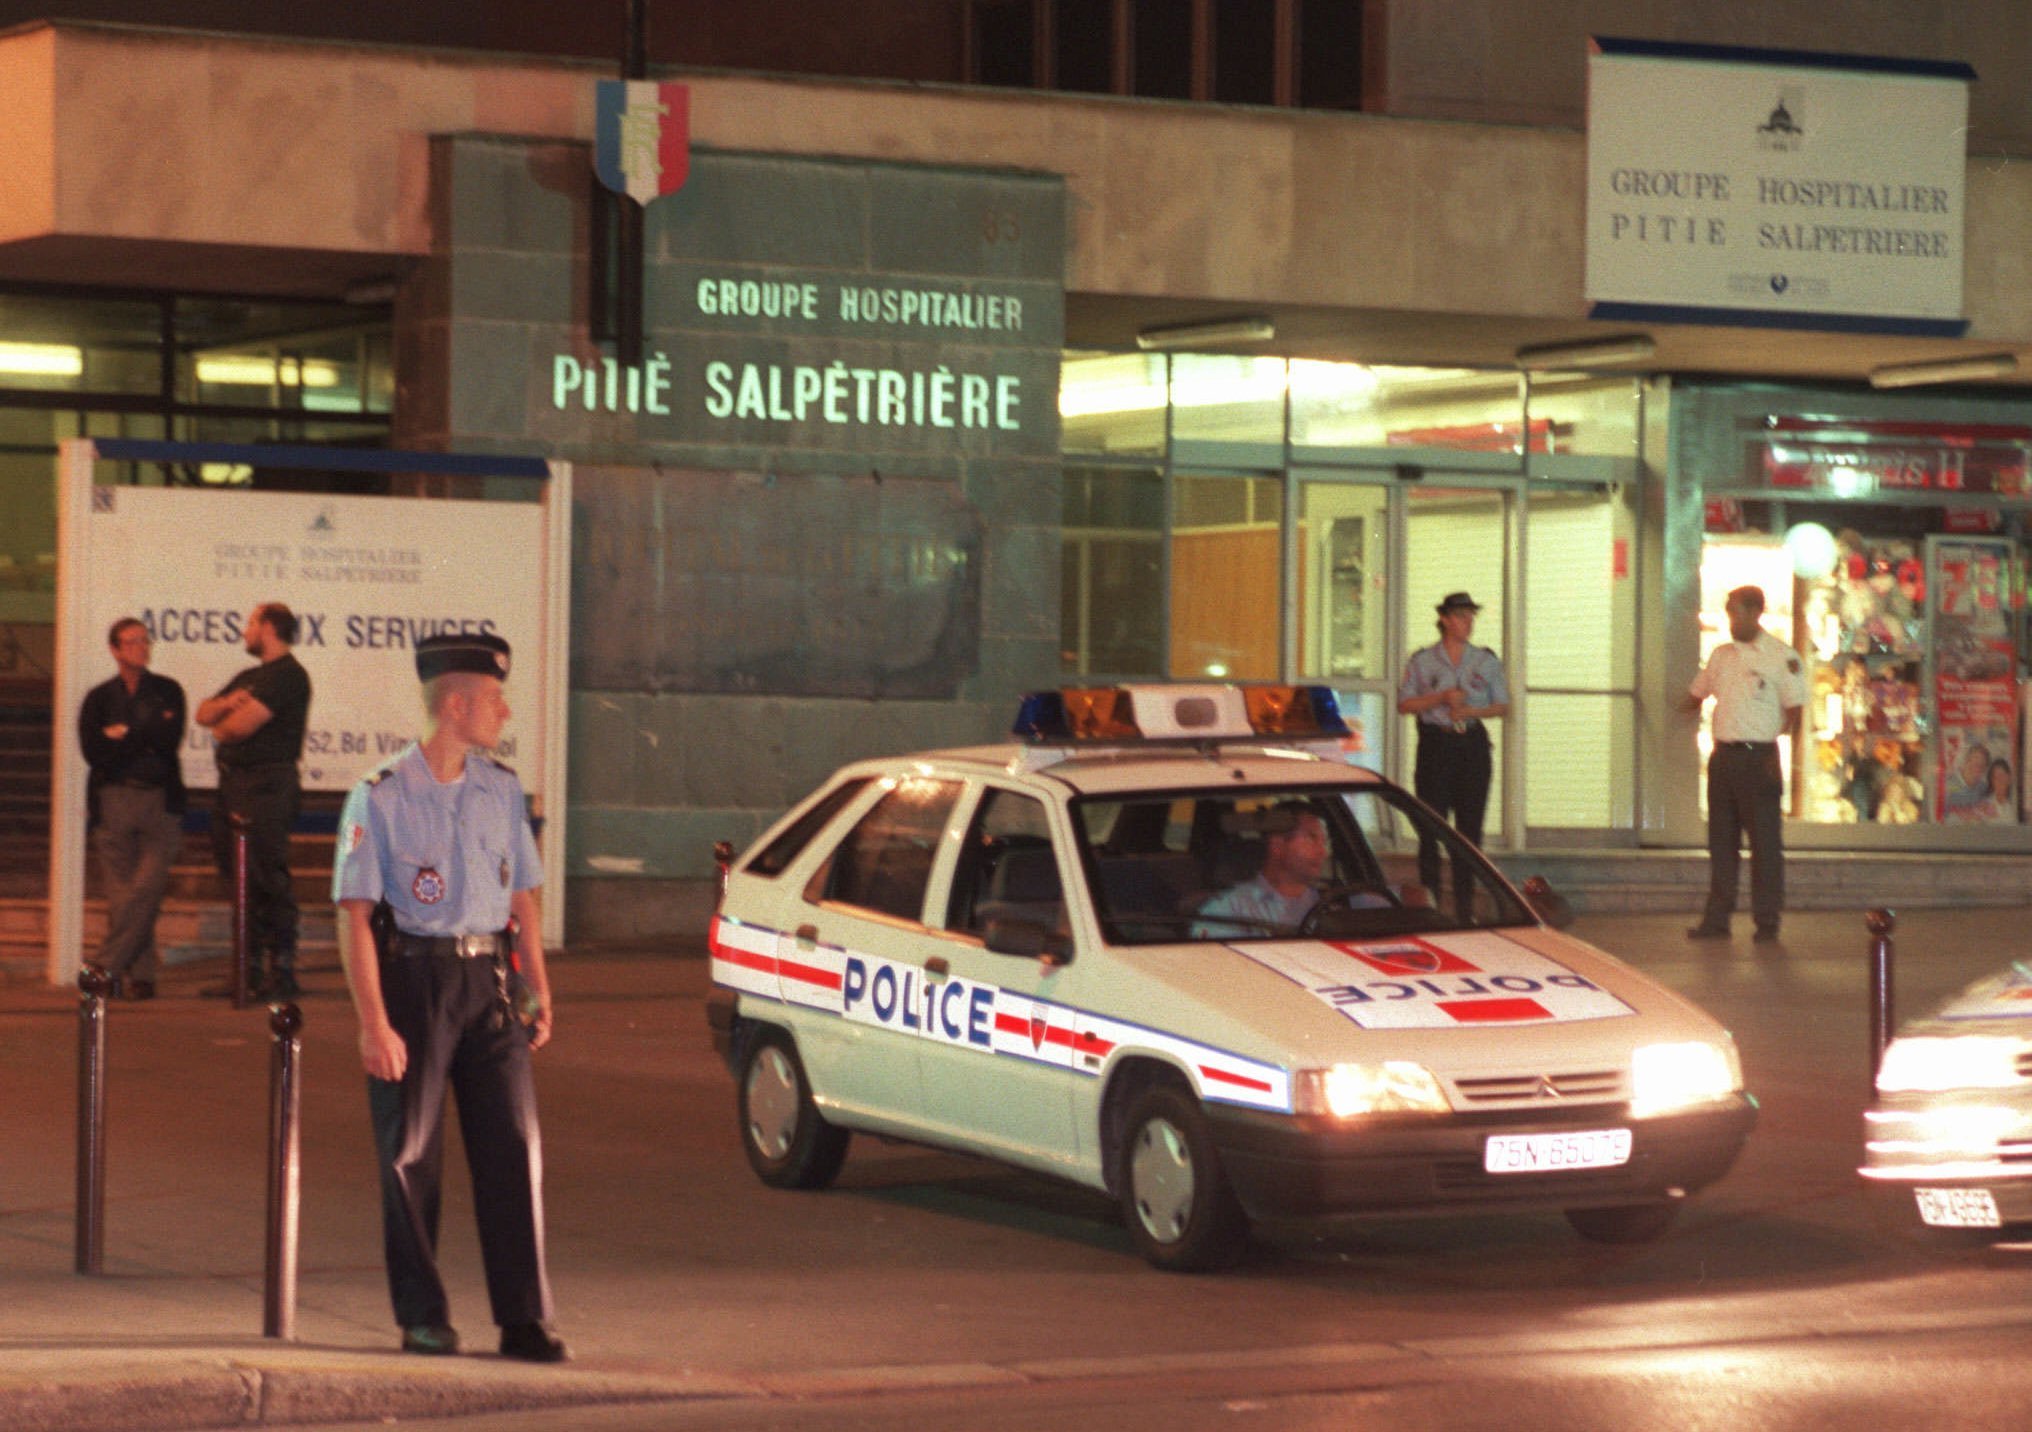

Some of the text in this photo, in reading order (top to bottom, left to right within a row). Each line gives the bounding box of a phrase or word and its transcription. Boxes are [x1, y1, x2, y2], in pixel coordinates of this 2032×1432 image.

[1611, 168, 1949, 214] GROUPE HOSPITALIER
[1611, 213, 1949, 259] PITIE SALPETRIERE
[697, 278, 1023, 331] GROUPE HOSPITALIER
[142, 607, 243, 645] ACCES
[844, 956, 994, 1047] POLICE
